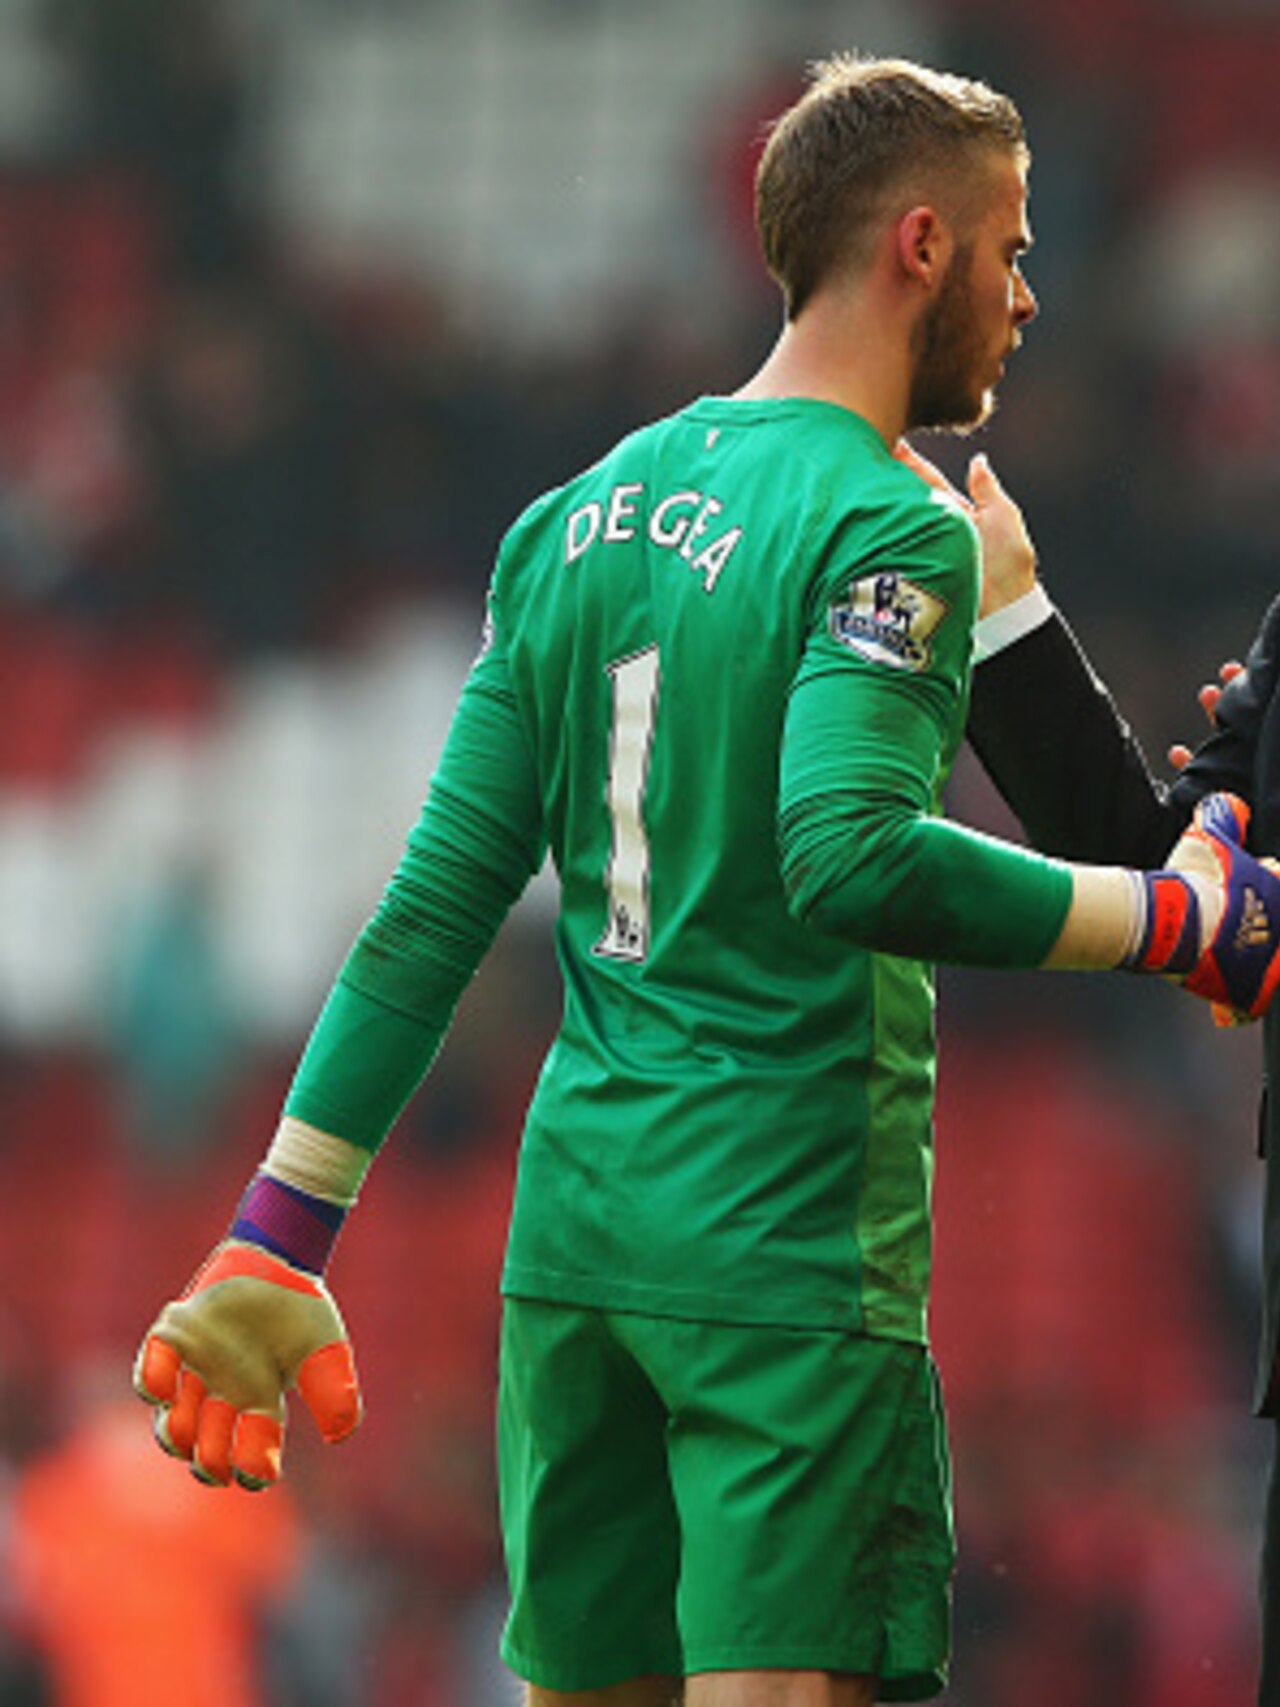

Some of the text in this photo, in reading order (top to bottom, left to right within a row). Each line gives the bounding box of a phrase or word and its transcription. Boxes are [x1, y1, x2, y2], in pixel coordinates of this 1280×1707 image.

[565, 482, 743, 593] DE GEA
[593, 643, 660, 960] 1
